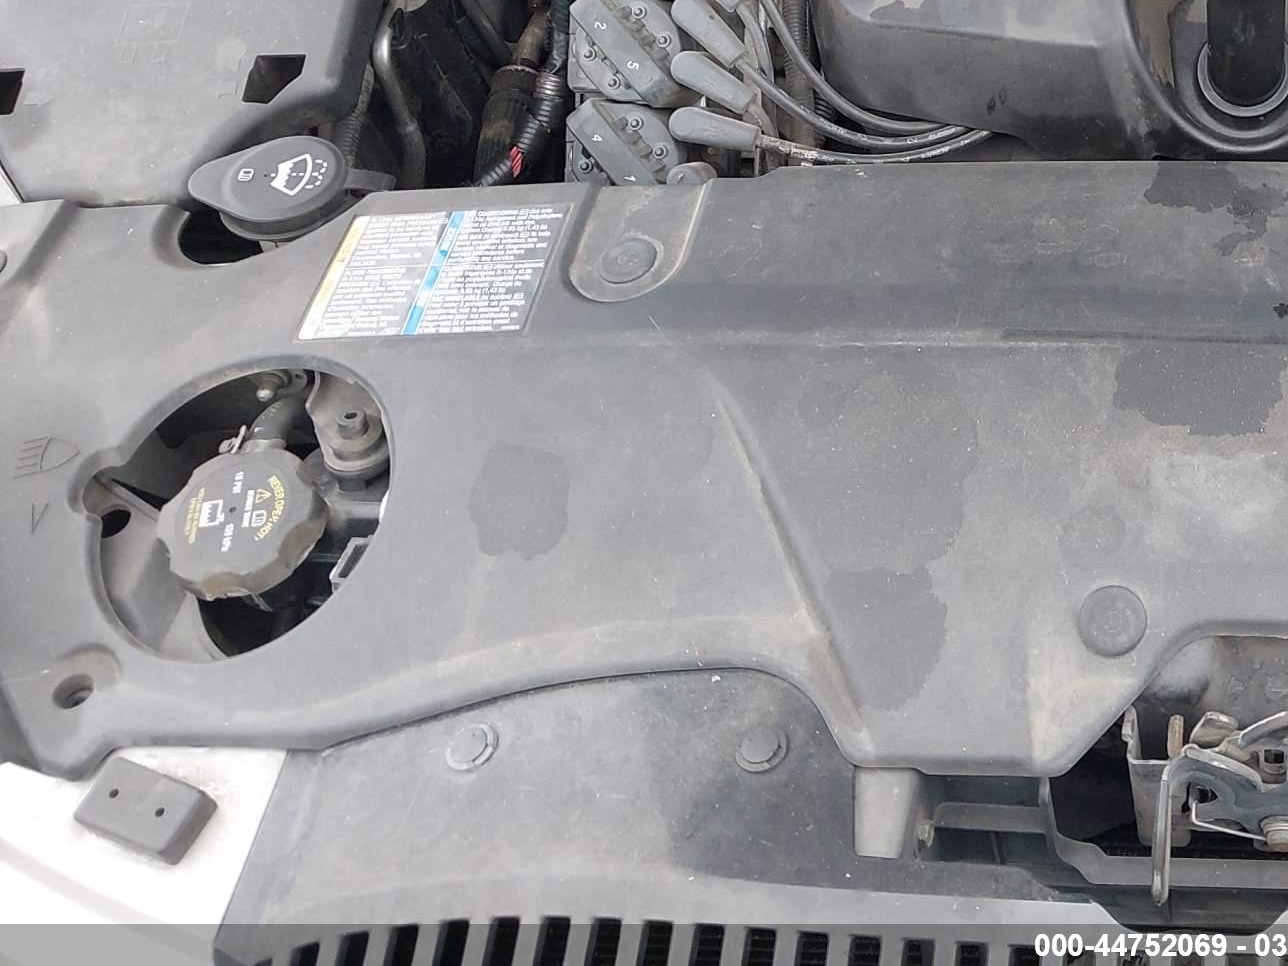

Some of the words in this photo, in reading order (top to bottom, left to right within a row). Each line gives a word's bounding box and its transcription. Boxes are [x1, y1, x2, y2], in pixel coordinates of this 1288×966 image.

[594, 21, 607, 30] 2
[626, 60, 640, 70] 5
[591, 134, 603, 142] 4
